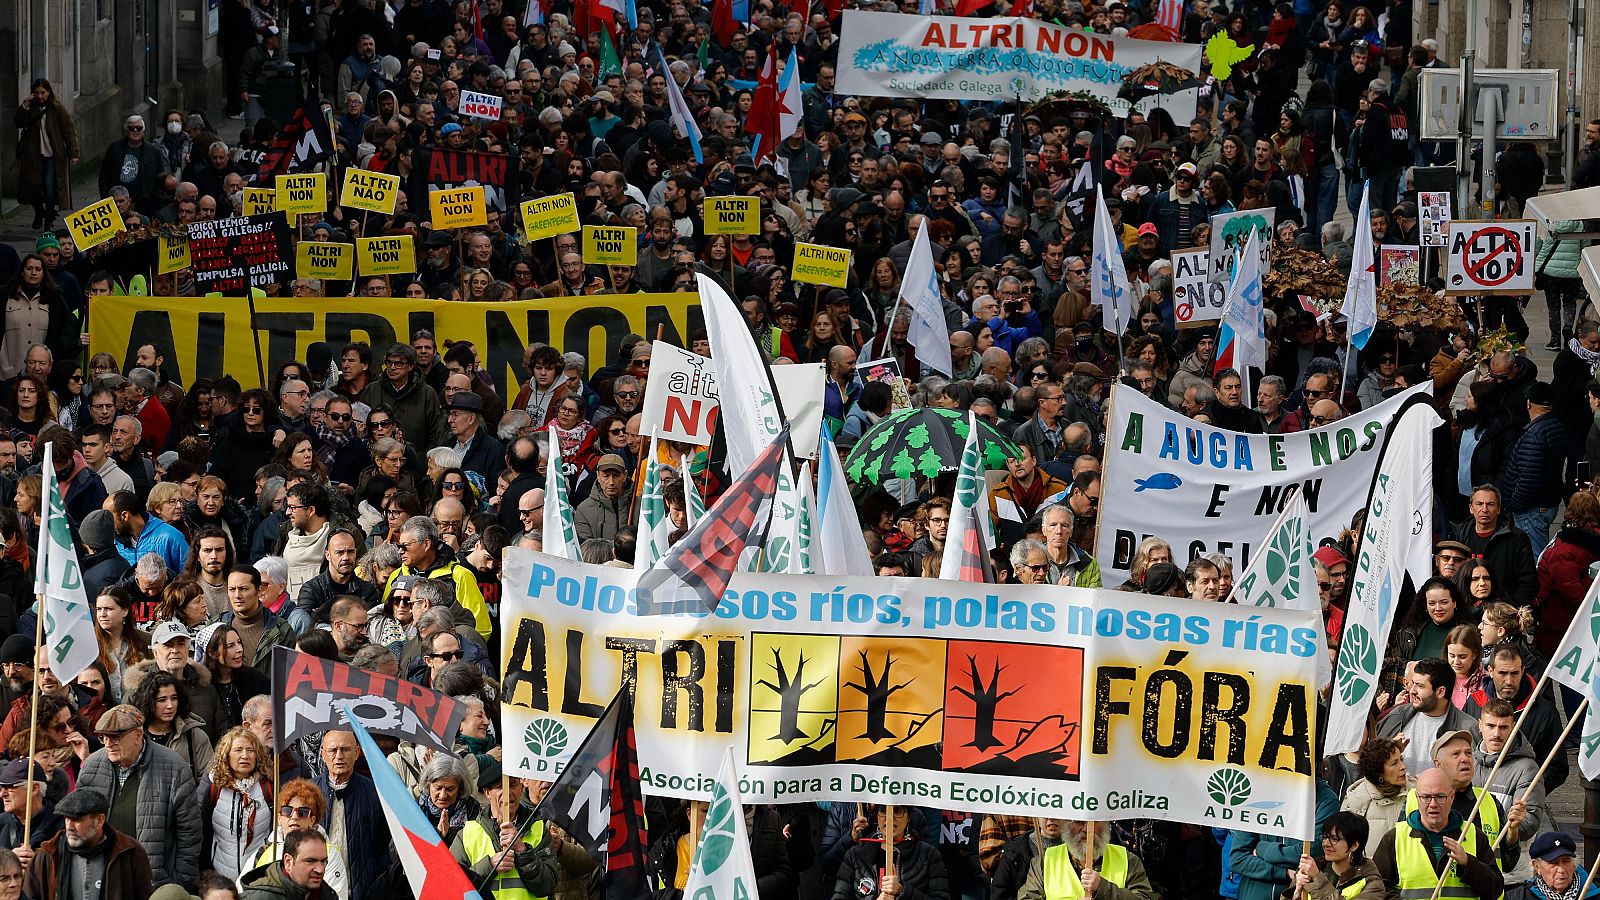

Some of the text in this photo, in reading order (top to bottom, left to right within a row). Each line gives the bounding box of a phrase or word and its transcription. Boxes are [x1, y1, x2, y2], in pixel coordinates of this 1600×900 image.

[921, 22, 1115, 62] ALTRI NON
[872, 50, 886, 64] A
[892, 51, 943, 66] NOSA
[948, 52, 1005, 68] TERRA,
[1012, 54, 1022, 66] O
[1027, 57, 1074, 75] NOSO
[889, 78, 954, 91] Sociedade
[959, 80, 1002, 95] Galega
[466, 93, 496, 105] ALTRI
[465, 104, 500, 117] NON
[1391, 128, 1408, 140] NON
[285, 177, 316, 189] ALTRI
[349, 174, 394, 191] ALTRI
[248, 193, 276, 204] ALT
[289, 190, 313, 201] NON
[353, 186, 385, 201] NÃO
[439, 192, 474, 205] ALTRI
[443, 204, 473, 216] NON
[527, 197, 571, 215] ALTRI NON
[714, 200, 748, 211] ALTRI
[73, 203, 113, 229] ALTRI
[718, 212, 745, 223] NON
[1422, 209, 1430, 218] A
[81, 217, 112, 238] NÃO
[187, 217, 250, 233] BOICOTEEMOS
[191, 221, 273, 239] COMA GALEGAS!!
[528, 213, 574, 232] GREENPEACE
[1432, 222, 1439, 232] T
[167, 236, 187, 248] ALTRI
[592, 229, 626, 240] ALTRI
[1423, 235, 1432, 245] R
[168, 246, 185, 259] NON
[307, 245, 342, 256] ALTRI
[368, 239, 401, 252] ALTRI
[597, 241, 622, 252] NON
[311, 257, 337, 268] NON
[372, 251, 399, 263] NON
[799, 247, 846, 263] ALTRI NON
[196, 261, 288, 281] IMPULSA GALICIA
[795, 263, 844, 278] GREENPEACE
[250, 272, 275, 286] NON
[485, 304, 706, 402] NON
[668, 368, 720, 401] alt
[1120, 411, 1144, 454] A
[1159, 420, 1254, 472] AUGA
[1268, 435, 1288, 472] E
[1204, 477, 1324, 518] E NON
[1355, 473, 1390, 602] ADEGA
[527, 563, 656, 616] Polos
[809, 585, 911, 629] ríos,
[923, 594, 1056, 632] polas
[1067, 605, 1210, 645] nosas
[1222, 615, 1317, 658] rías
[284, 652, 456, 739] ALTRI
[500, 617, 1312, 777] ALTRI FÓRA
[284, 692, 450, 751] NON
[639, 767, 1169, 811] Asociaón para a Defensa Ecolóxica de Galiza
[1204, 805, 1285, 828] ADEGA
